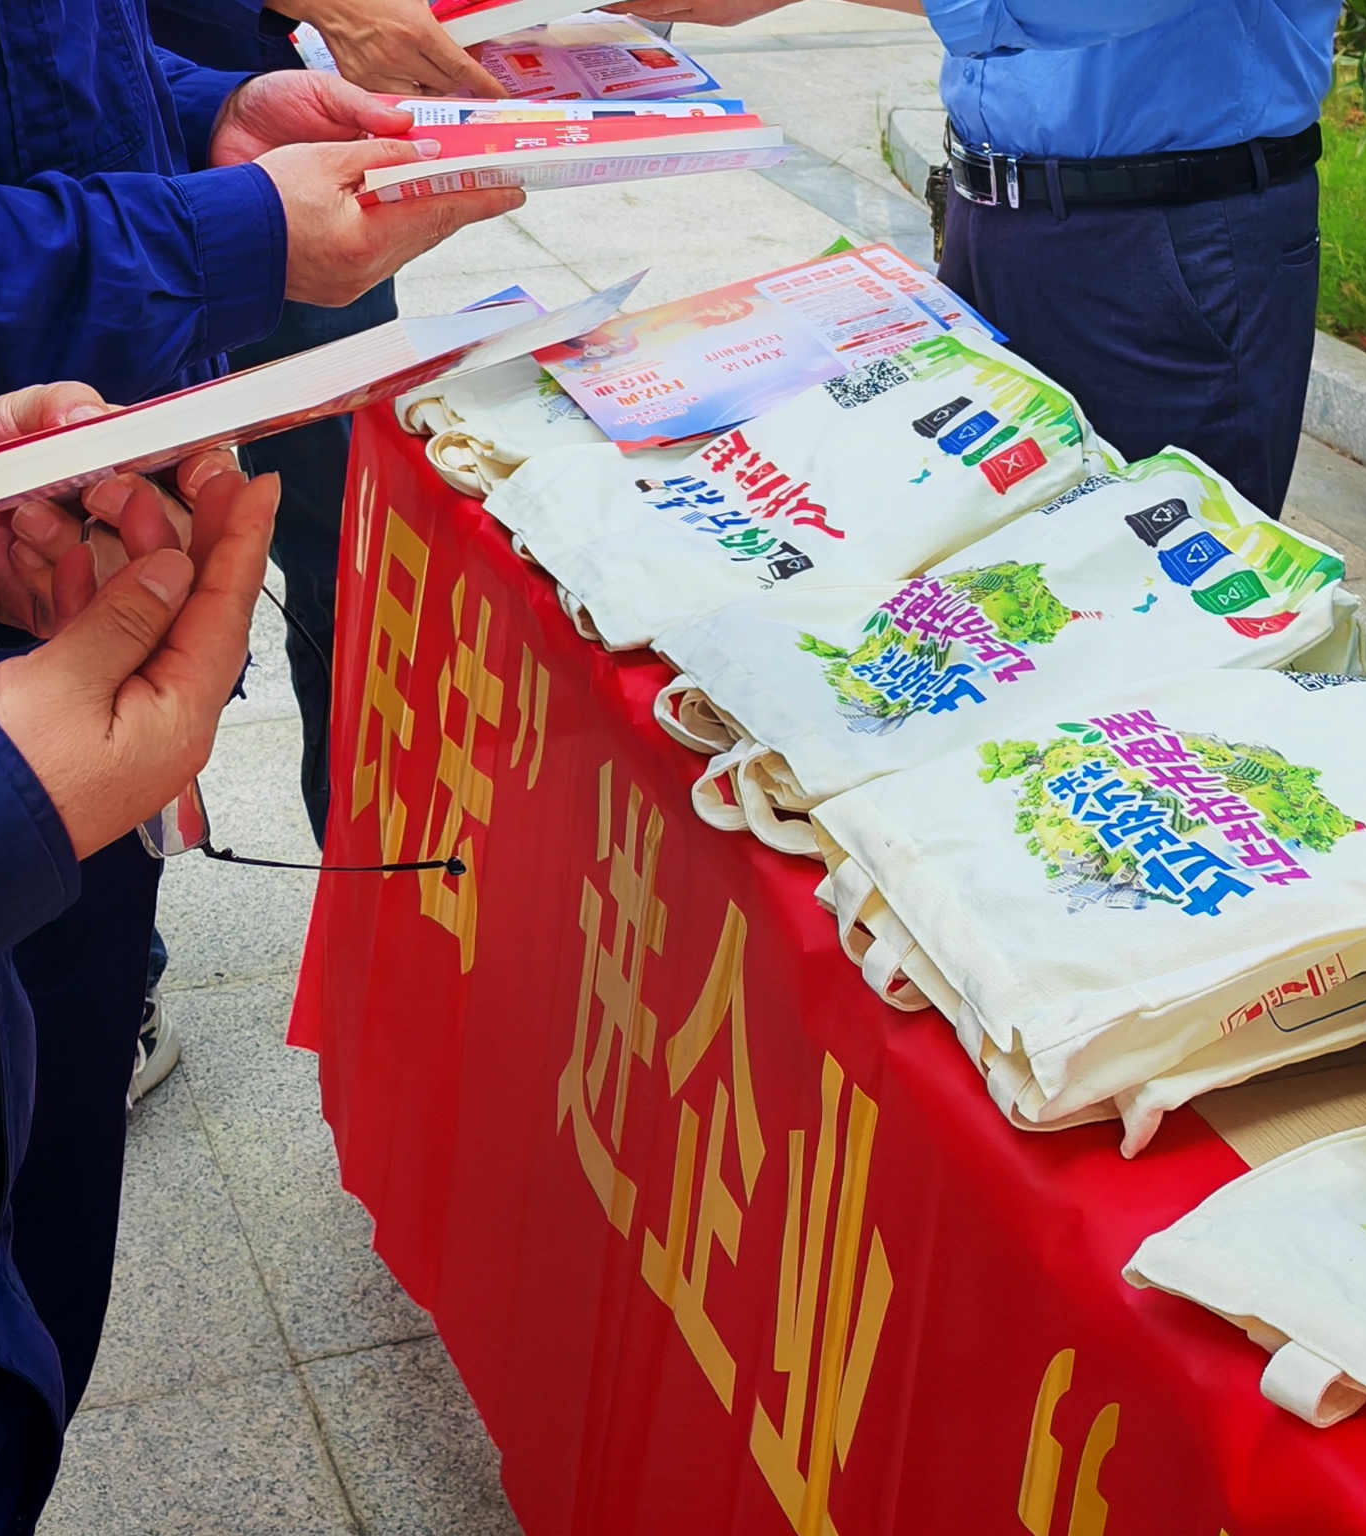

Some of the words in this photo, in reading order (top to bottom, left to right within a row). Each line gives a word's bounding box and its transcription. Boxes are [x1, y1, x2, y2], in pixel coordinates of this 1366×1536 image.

[616, 376, 686, 408] 民法典
[1046, 760, 1255, 917] 垃圾分类
[1088, 710, 1313, 886] 让城市更美
